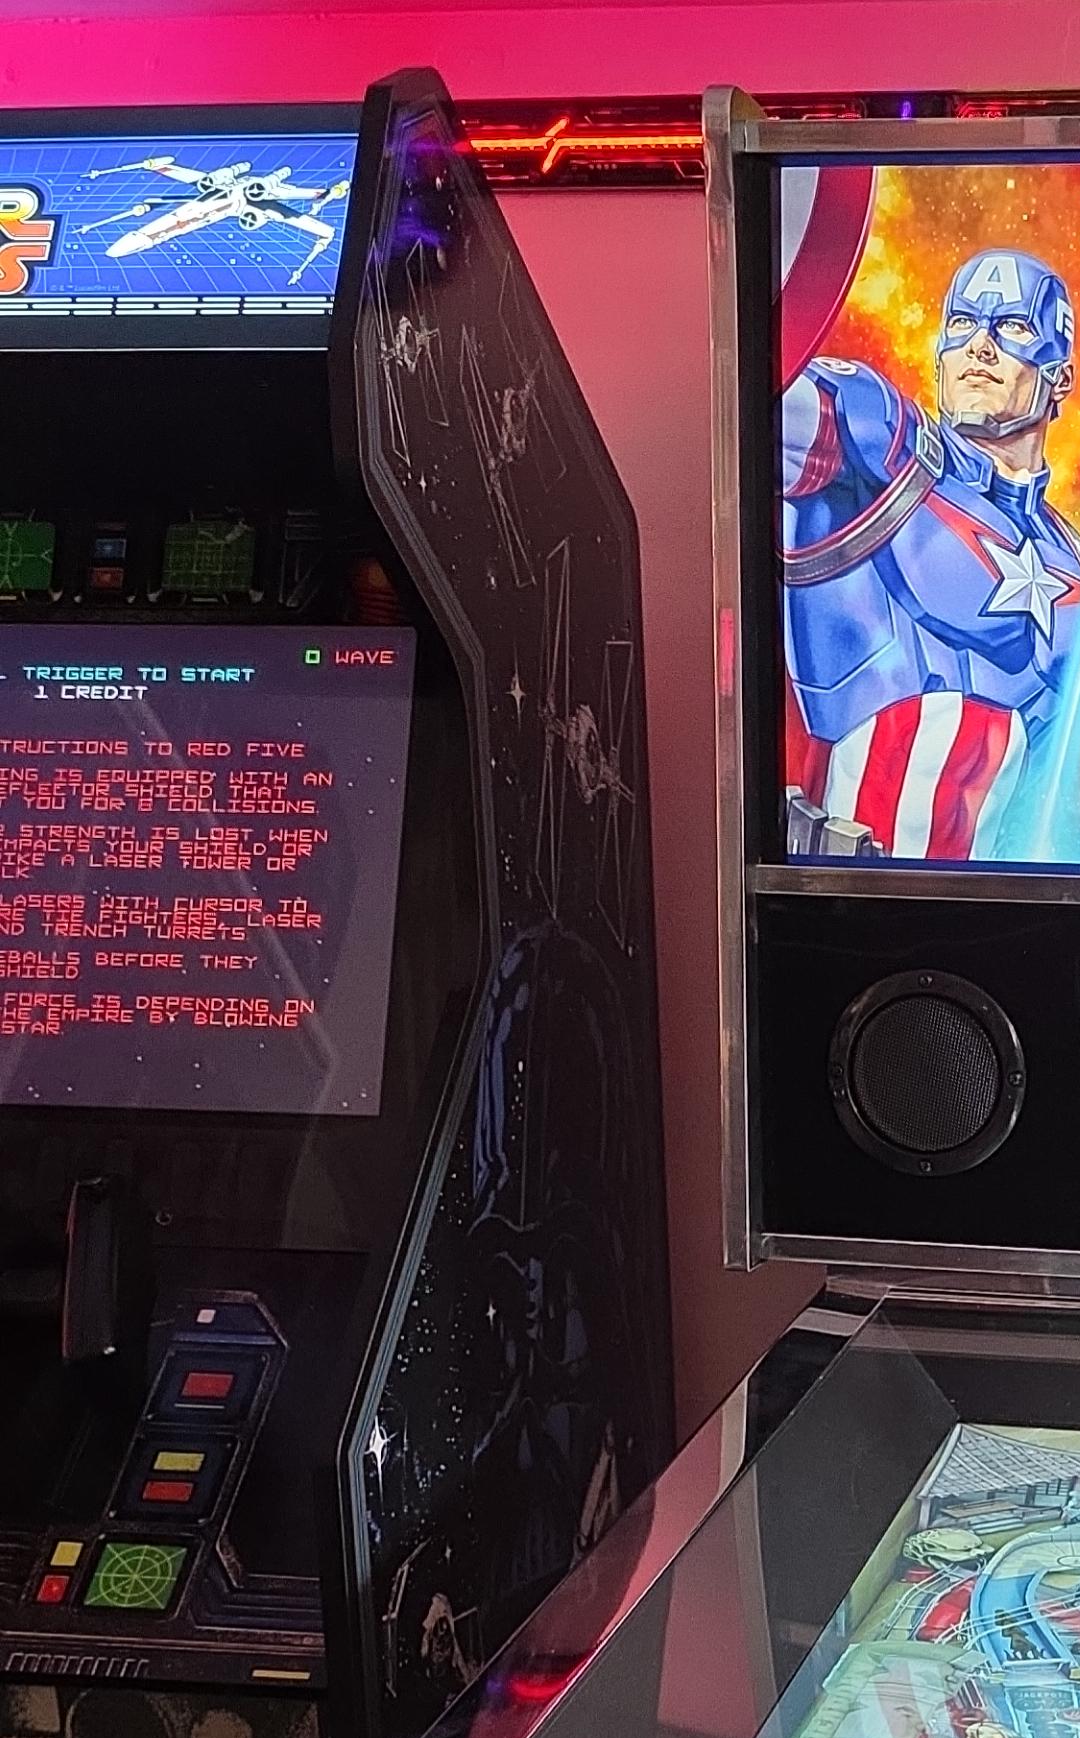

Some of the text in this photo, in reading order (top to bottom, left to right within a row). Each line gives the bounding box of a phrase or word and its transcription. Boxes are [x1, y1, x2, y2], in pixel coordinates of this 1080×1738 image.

[335, 650, 395, 664] WAVE
[23, 666, 256, 682] TRIGGER TO START
[34, 685, 149, 700] 1 CREDIT
[0, 739, 305, 757] TRUCTIONS TO RED FIVE
[55, 769, 83, 782] IS
[97, 769, 216, 784] EQUIPPED
[229, 771, 288, 785] WITH
[303, 772, 333, 786] AN
[124, 784, 213, 798] SHIELD
[229, 786, 287, 799] THAT
[23, 796, 66, 810] YOU
[81, 797, 125, 811] FOR
[20, 824, 136, 839] STRENGTH
[151, 827, 180, 840] IS
[195, 827, 254, 841] LOST
[269, 829, 328, 843] WHEN
[0, 839, 313, 857] MPACTS YOUR SHIELD OR
[61, 853, 75, 867] A
[89, 854, 163, 868] LASER
[179, 856, 251, 871] TOWER
[266, 857, 297, 871] OR
[0, 894, 307, 913] LASERS WITH CURSOR TO
[42, 909, 84, 923] TIE
[247, 914, 322, 928] LASER
[41, 923, 127, 938] TRENCH
[95, 952, 185, 967] BEFORE
[200, 955, 259, 969] THEY
[4, 992, 315, 1013] FORCE IS DEPENDING ON
[0, 1007, 299, 1027] HE EMPIRE BY BLOWING
